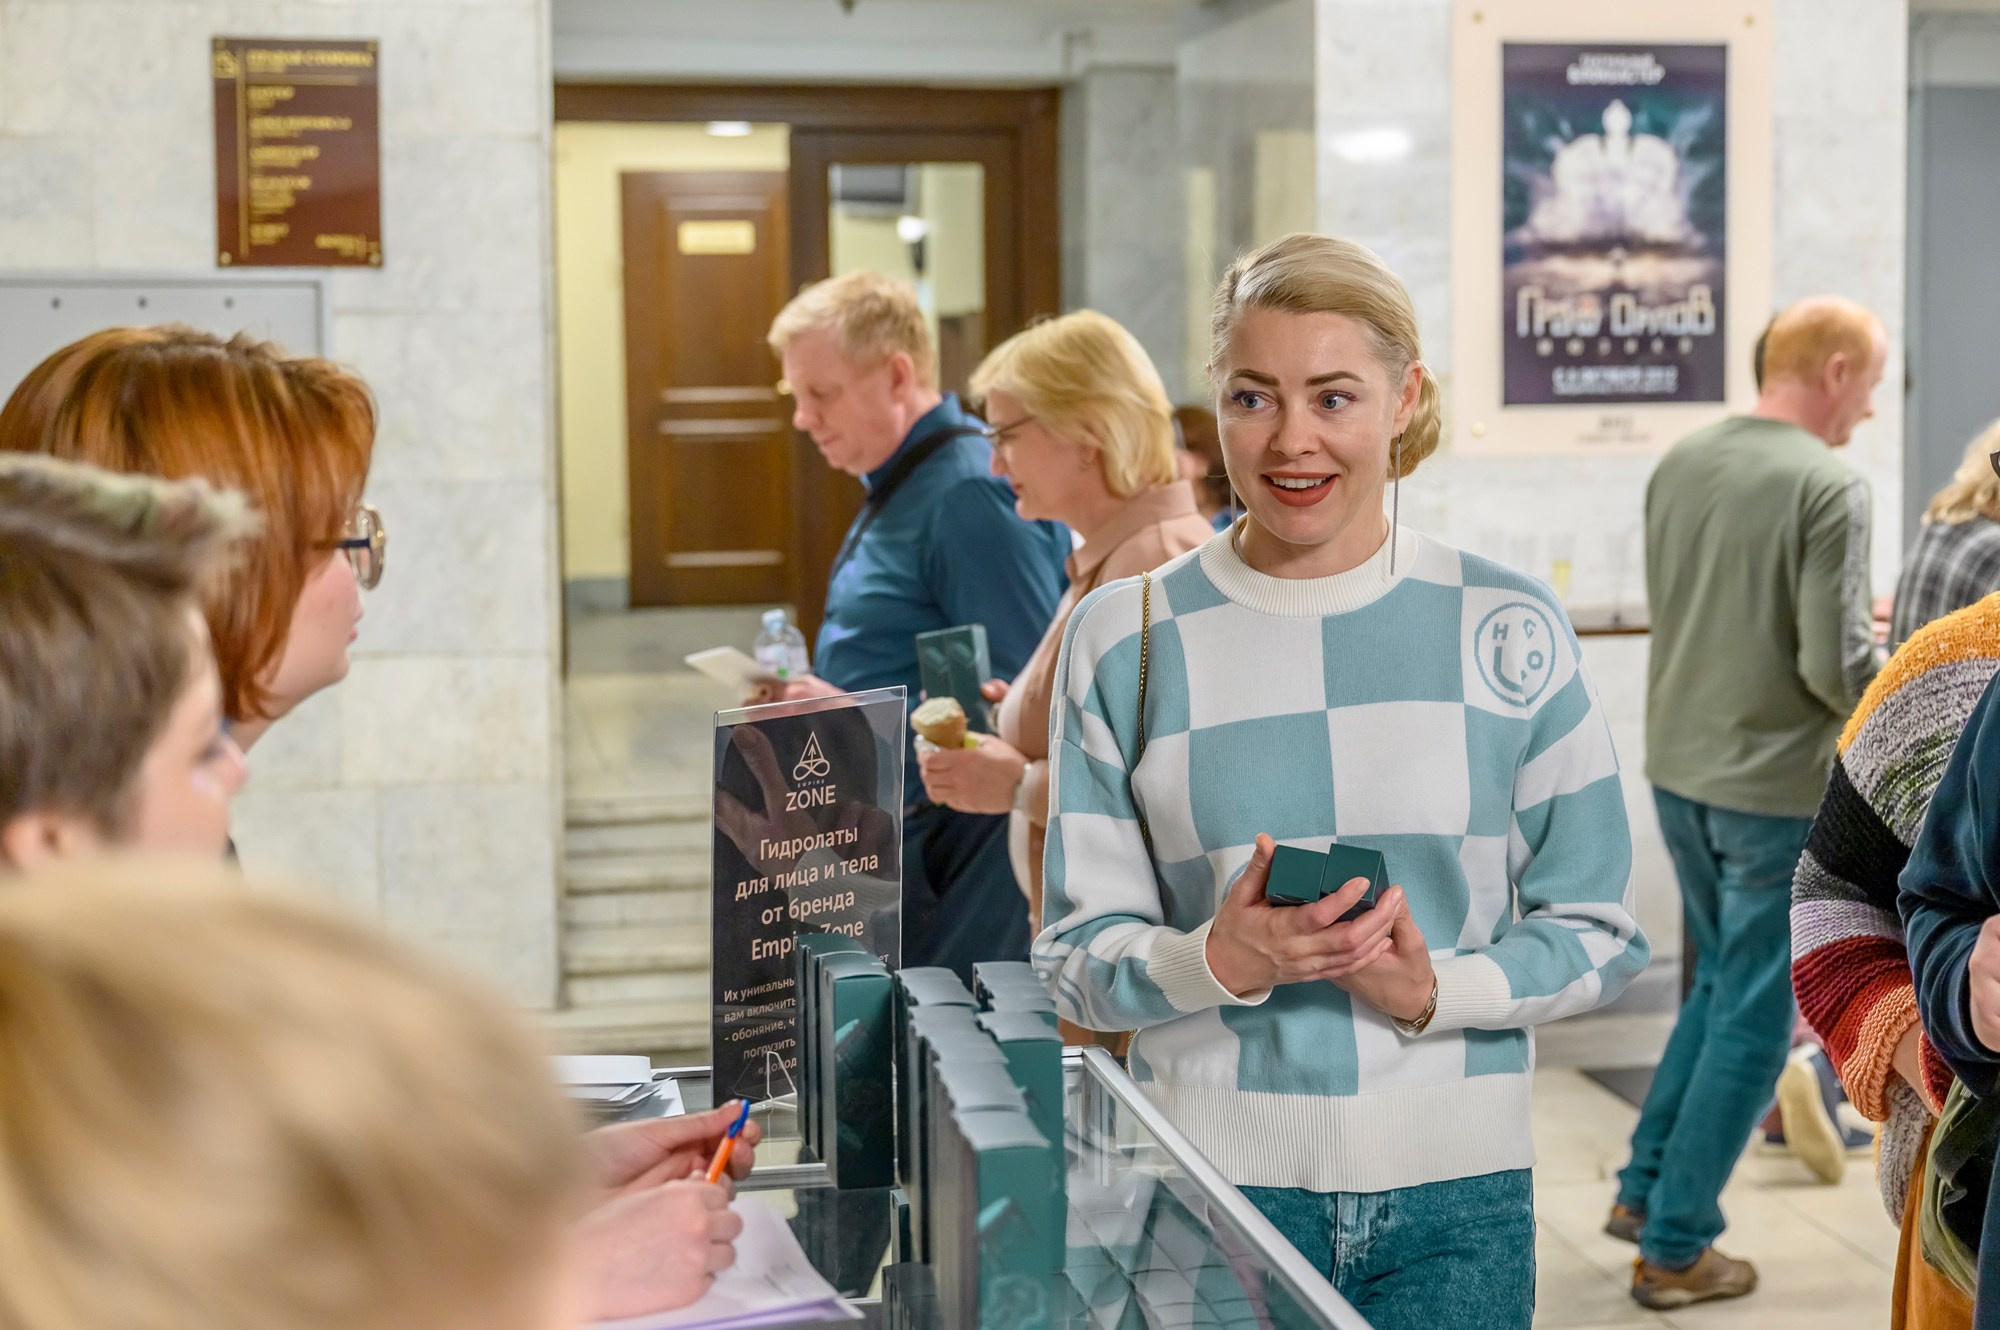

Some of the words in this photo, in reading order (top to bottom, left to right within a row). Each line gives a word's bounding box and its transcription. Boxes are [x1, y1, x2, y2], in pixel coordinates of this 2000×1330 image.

[785, 784, 836, 812] ZONE
[760, 827, 858, 861] Гидролаты
[735, 877, 769, 901] для
[774, 866, 819, 890] лица
[824, 863, 835, 880] и
[839, 854, 879, 876] тела
[761, 906, 784, 925] от
[788, 890, 855, 922] бренда
[752, 931, 798, 961] Empi
[724, 990, 739, 1003] Их
[724, 1011, 745, 1024] вам
[731, 1020, 787, 1042] обоняние,
